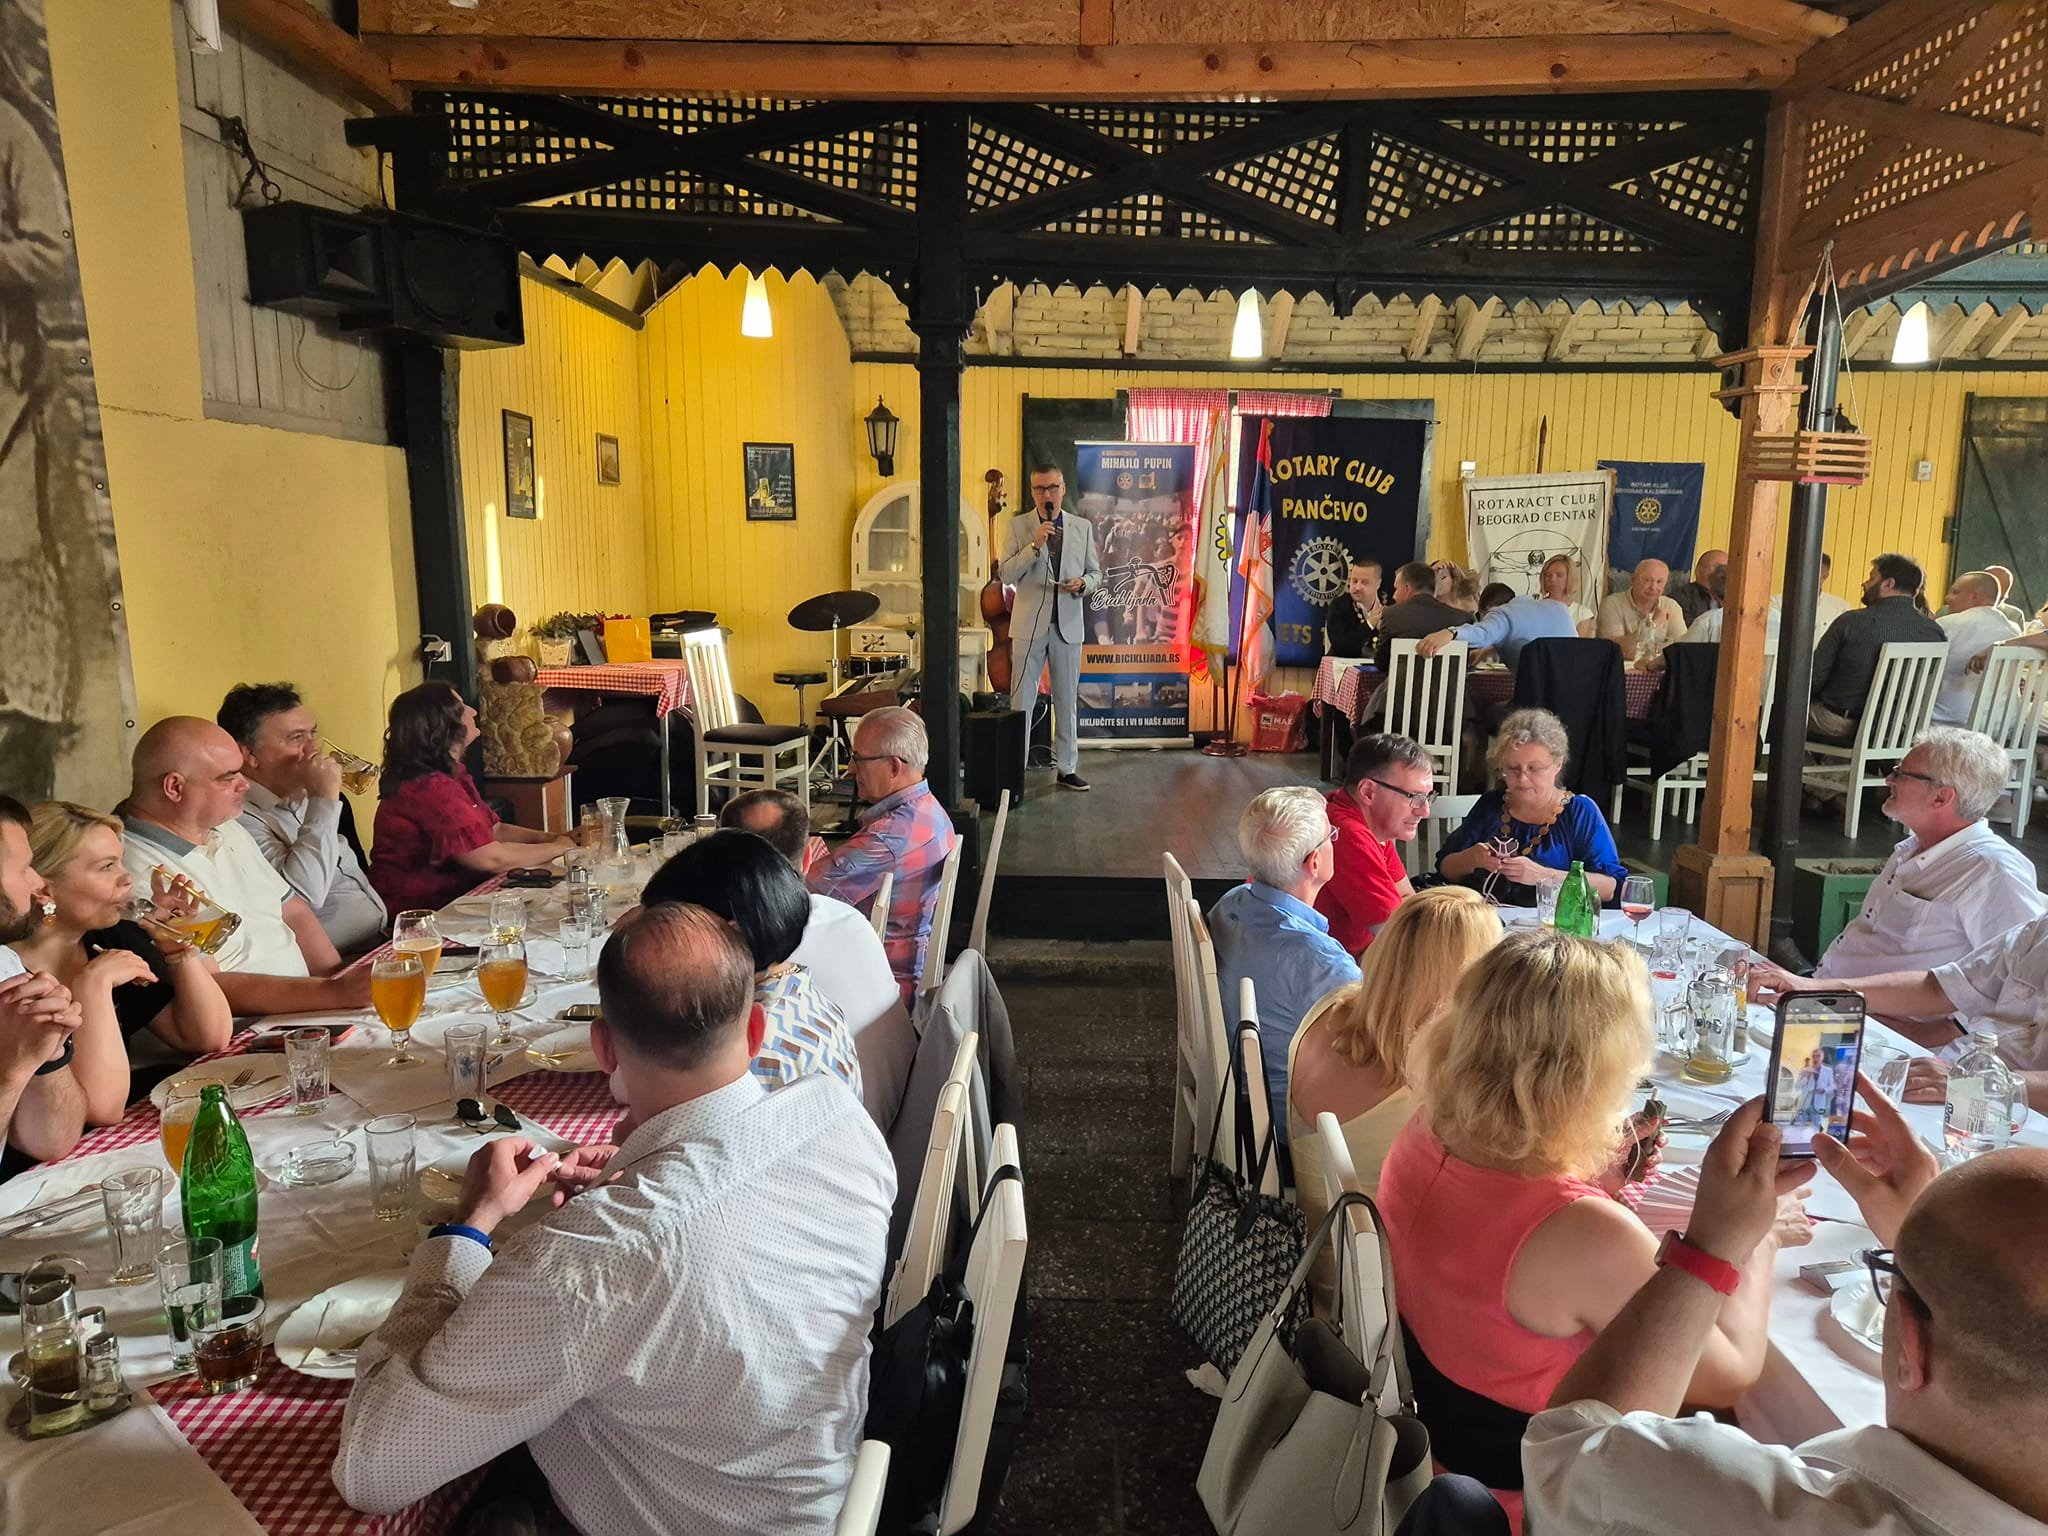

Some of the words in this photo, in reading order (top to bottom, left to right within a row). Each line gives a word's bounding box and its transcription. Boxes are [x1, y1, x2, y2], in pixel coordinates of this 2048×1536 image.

[1101, 457, 1140, 469] MIHAJLO
[1144, 457, 1172, 469] PUPIN
[1345, 460, 1395, 495] CLUB
[1282, 494, 1368, 522] PANČEVO
[1477, 496, 1554, 510] ROTARACT
[1561, 494, 1597, 506] CLUB
[1477, 513, 1540, 525] BEOGRAD
[1544, 509, 1597, 522] CENTAR
[1090, 588, 1158, 611] Biciklijada
[1086, 653, 1181, 664] WWW.BICIKLIJADA.RS
[1079, 717, 1116, 727] UKLJUČITE
[1116, 718, 1125, 727] SE
[1130, 718, 1137, 727] VI
[1138, 718, 1143, 727] U
[1144, 717, 1160, 726] NAŠE
[1162, 717, 1185, 726] AKCIJE
